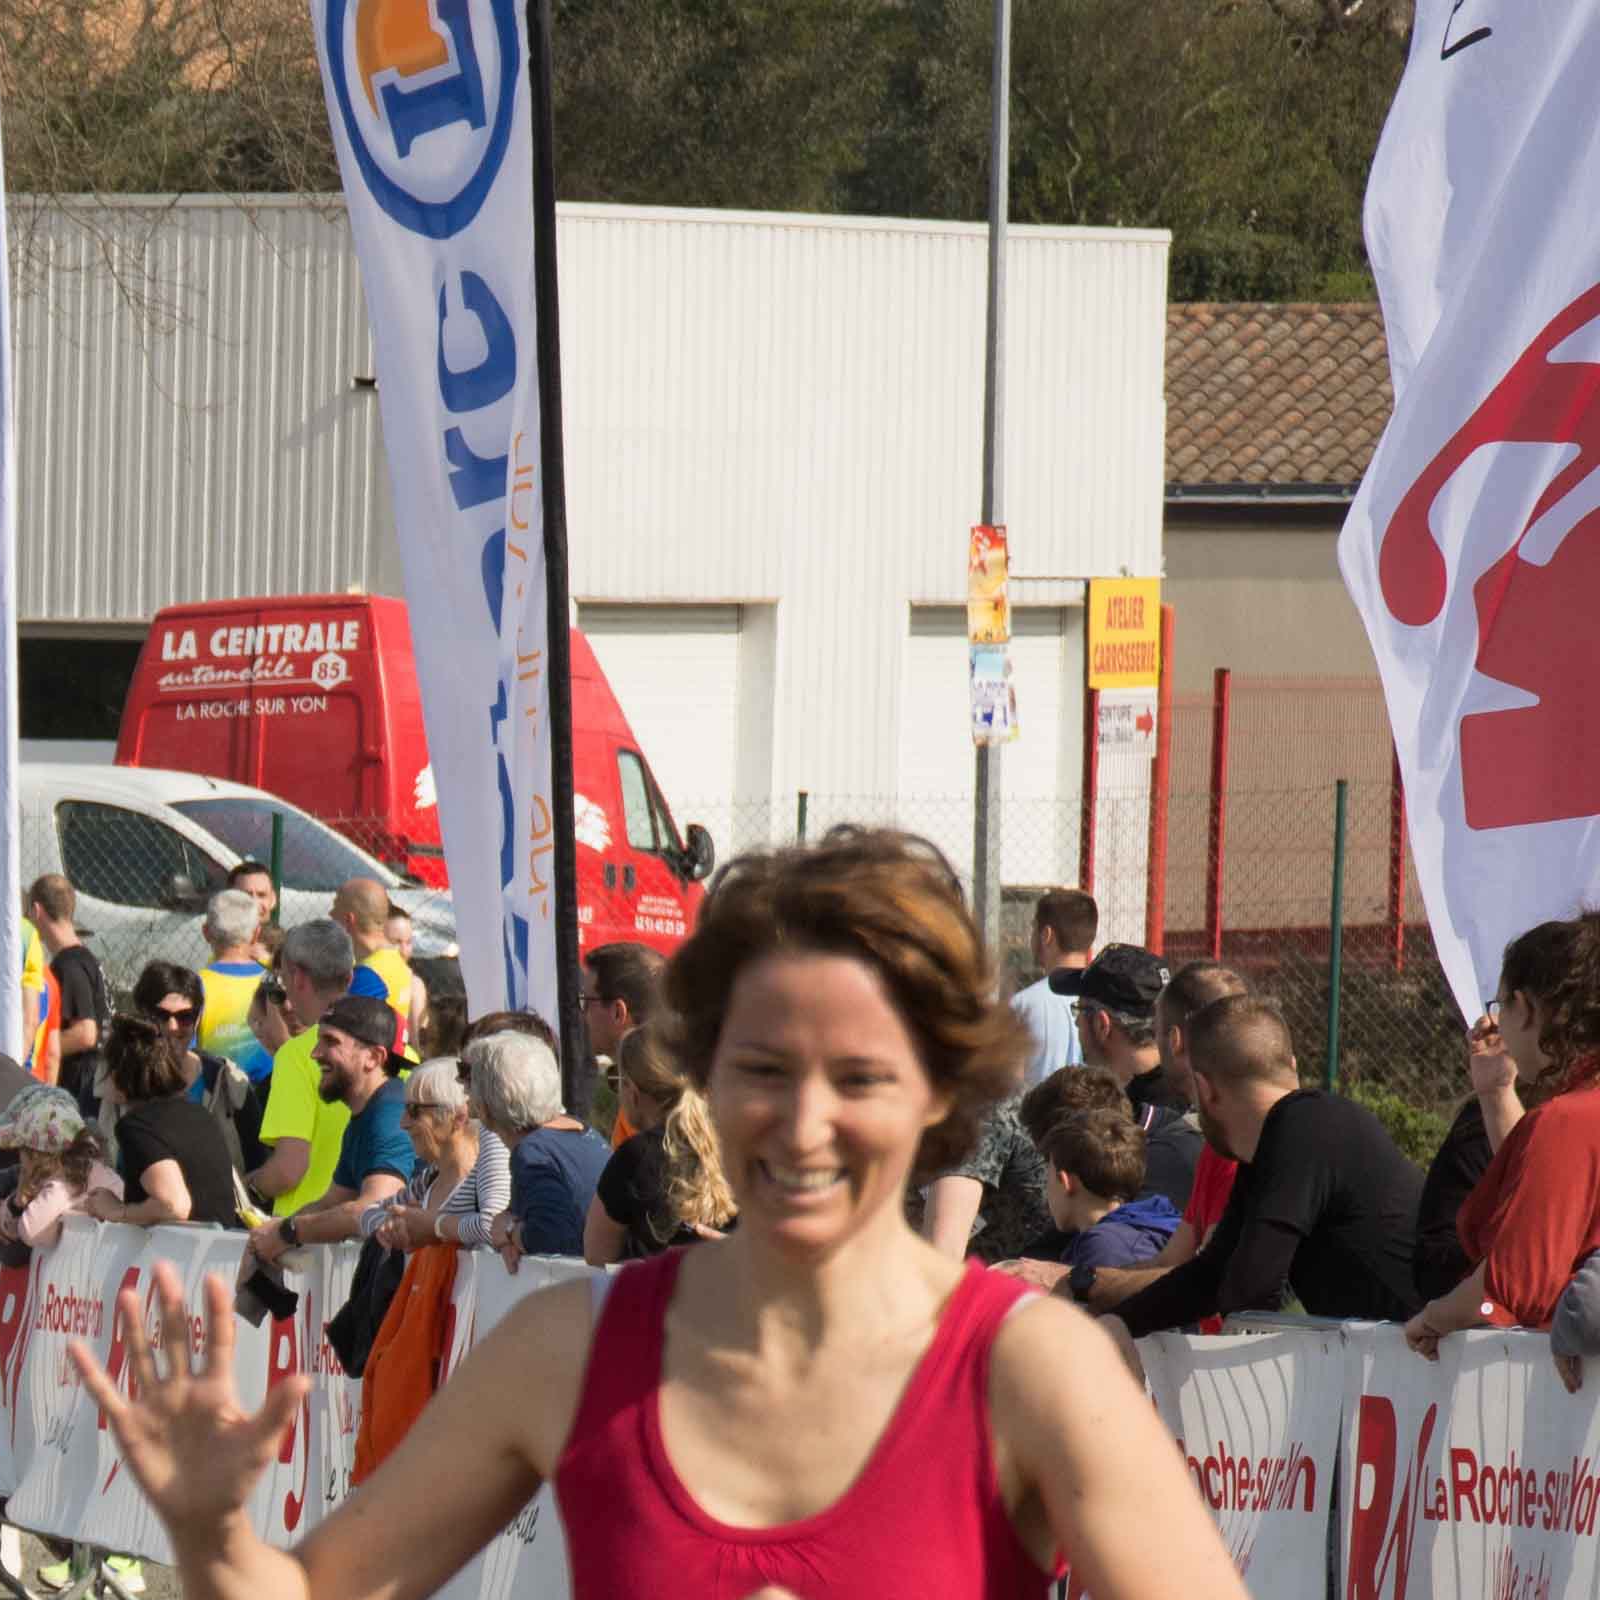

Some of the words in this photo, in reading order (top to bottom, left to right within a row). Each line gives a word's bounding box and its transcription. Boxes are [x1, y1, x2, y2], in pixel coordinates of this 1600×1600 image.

[1105, 596, 1145, 630] ATELIER
[161, 629, 198, 662] LA
[209, 620, 360, 657] CENTRALE
[1093, 640, 1156, 674] CARROSSERIE
[158, 655, 297, 687] automobile
[317, 661, 341, 680] 85
[176, 702, 196, 721] LA
[200, 697, 250, 720] ROCHE
[255, 698, 286, 716] SUR
[290, 695, 328, 714] YON
[1423, 1463, 1449, 1521] La
